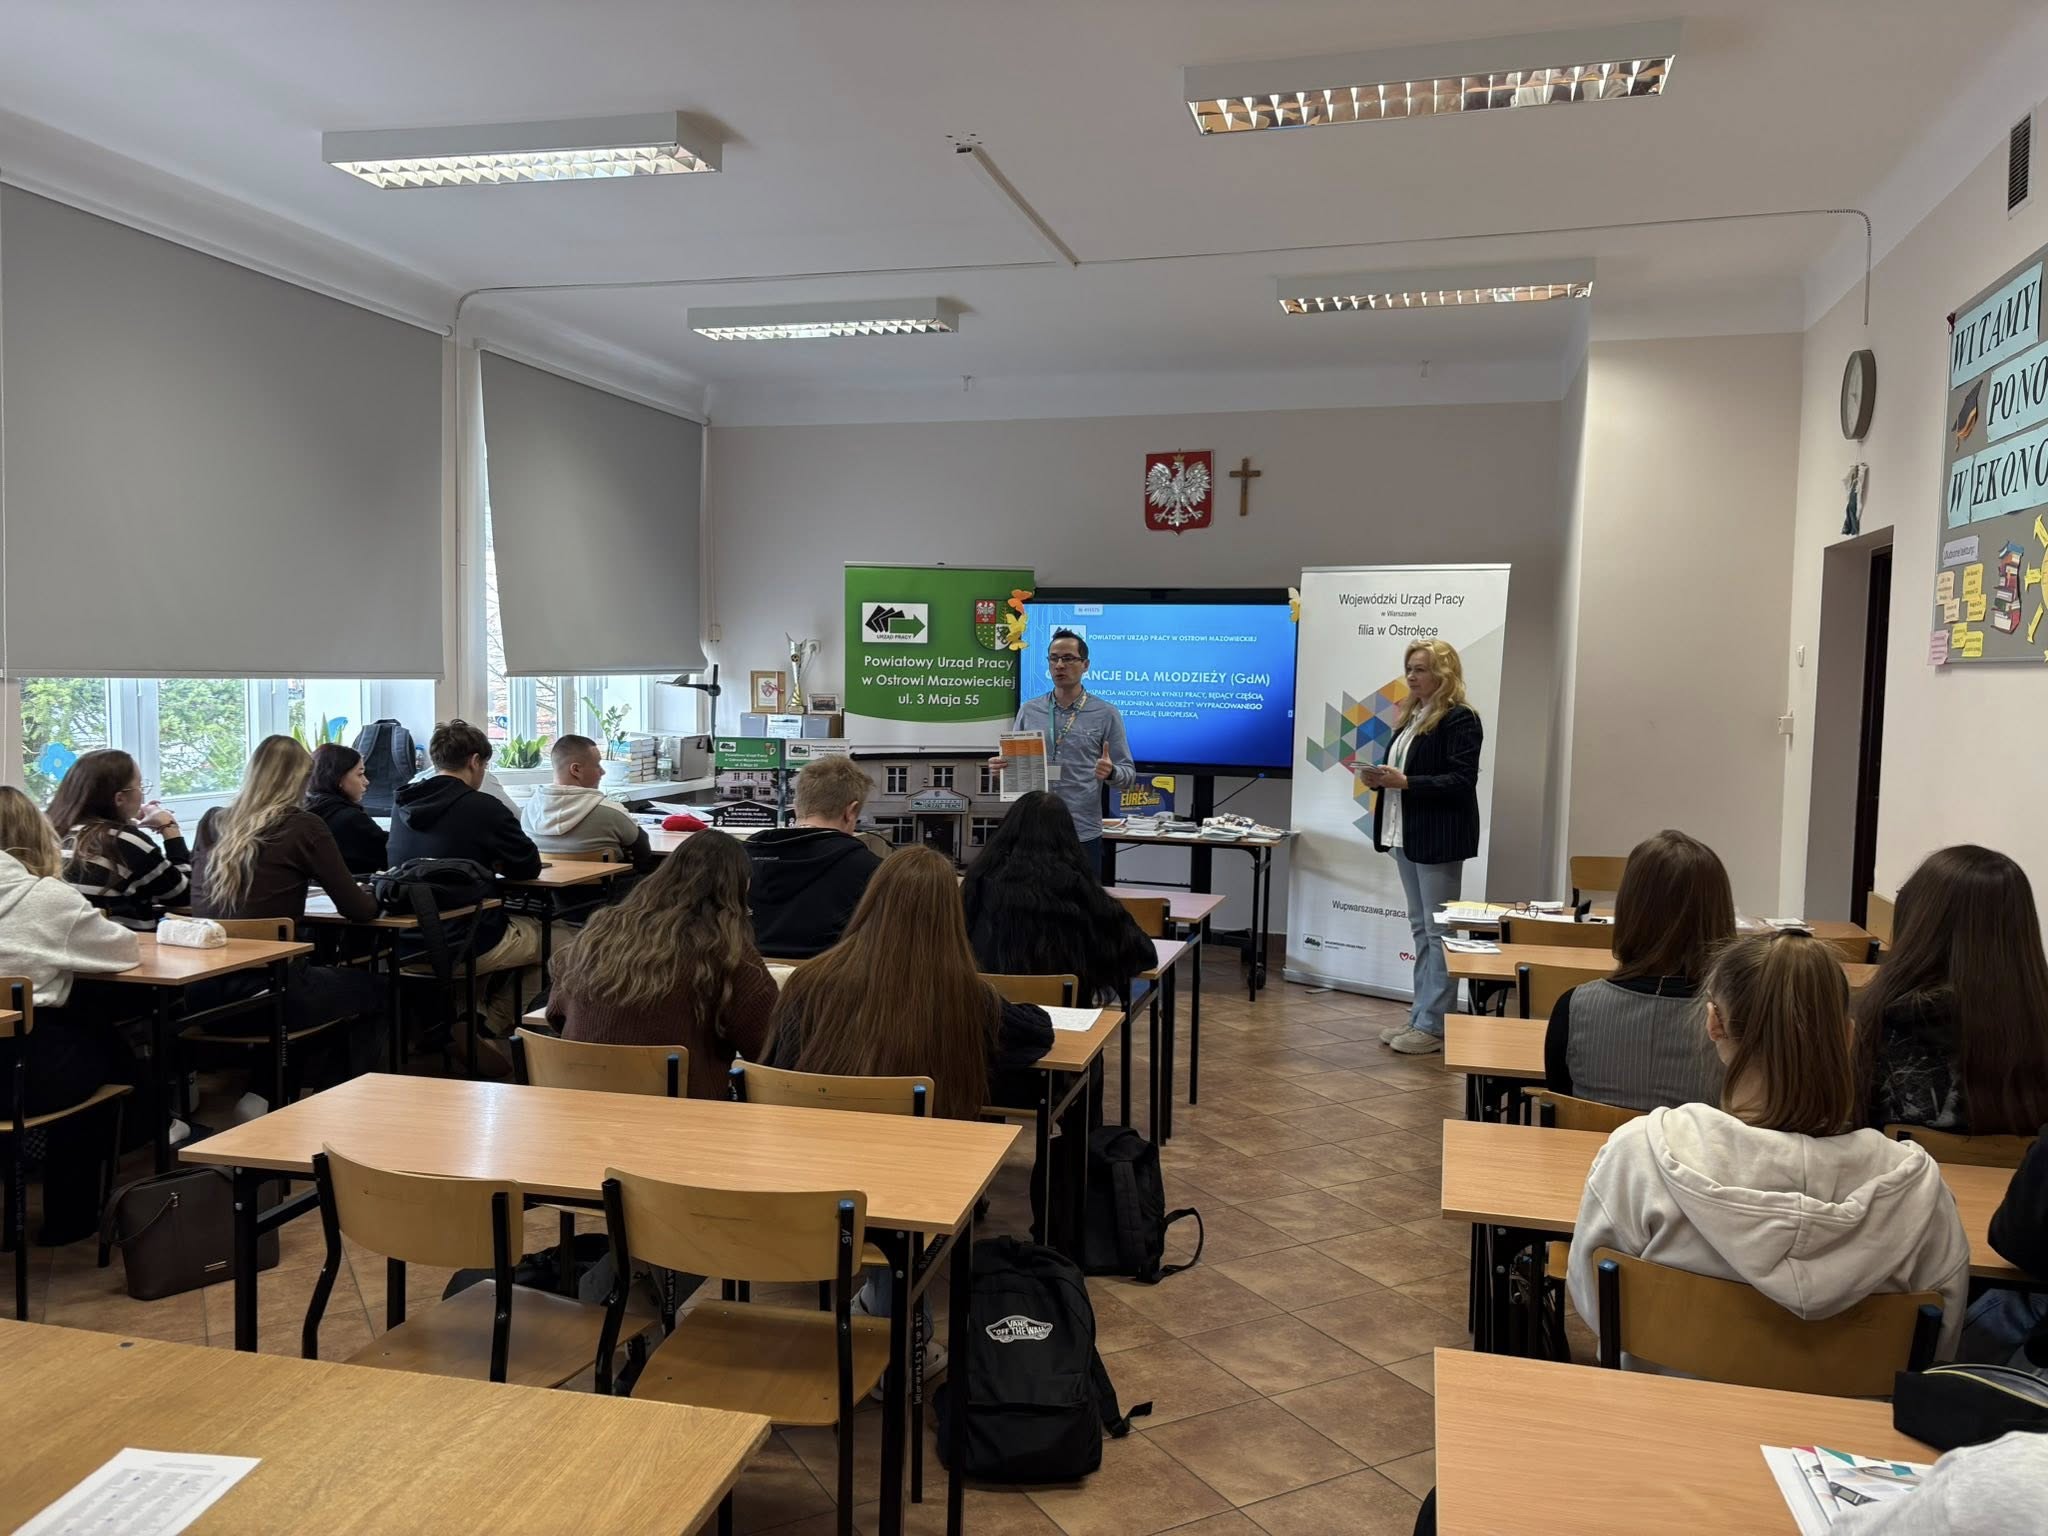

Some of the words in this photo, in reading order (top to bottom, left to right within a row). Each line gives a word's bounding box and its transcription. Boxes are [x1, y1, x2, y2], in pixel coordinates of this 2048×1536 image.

[1953, 280, 2037, 374] WITAMY
[1949, 469, 1969, 514] W
[1339, 592, 1398, 607] Wojewódzki
[1400, 592, 1431, 608] Urząd
[1434, 592, 1465, 608] Pracy
[1358, 624, 1375, 636] filia
[1377, 626, 1387, 636] w
[1388, 624, 1439, 637] Ostrołęce
[864, 655, 933, 670] Powiatowy
[937, 656, 974, 671] Urząd
[977, 657, 1014, 671] Pracy
[861, 677, 871, 686] w
[876, 674, 925, 687] Ostrowi
[927, 675, 1016, 690] Mazowieckiej
[1125, 670, 1150, 682] DLA
[1153, 669, 1227, 684] MŁODZIEŻY
[1230, 673, 1271, 687] (GdM)
[898, 693, 913, 705] ul.
[917, 694, 925, 705] 3
[928, 694, 961, 707] Maja
[964, 695, 980, 706] 55
[1332, 900, 1408, 918] Wupwarszawa.praca.
[1006, 1320, 1028, 1328] VANS
[1011, 1326, 1026, 1336] THE
